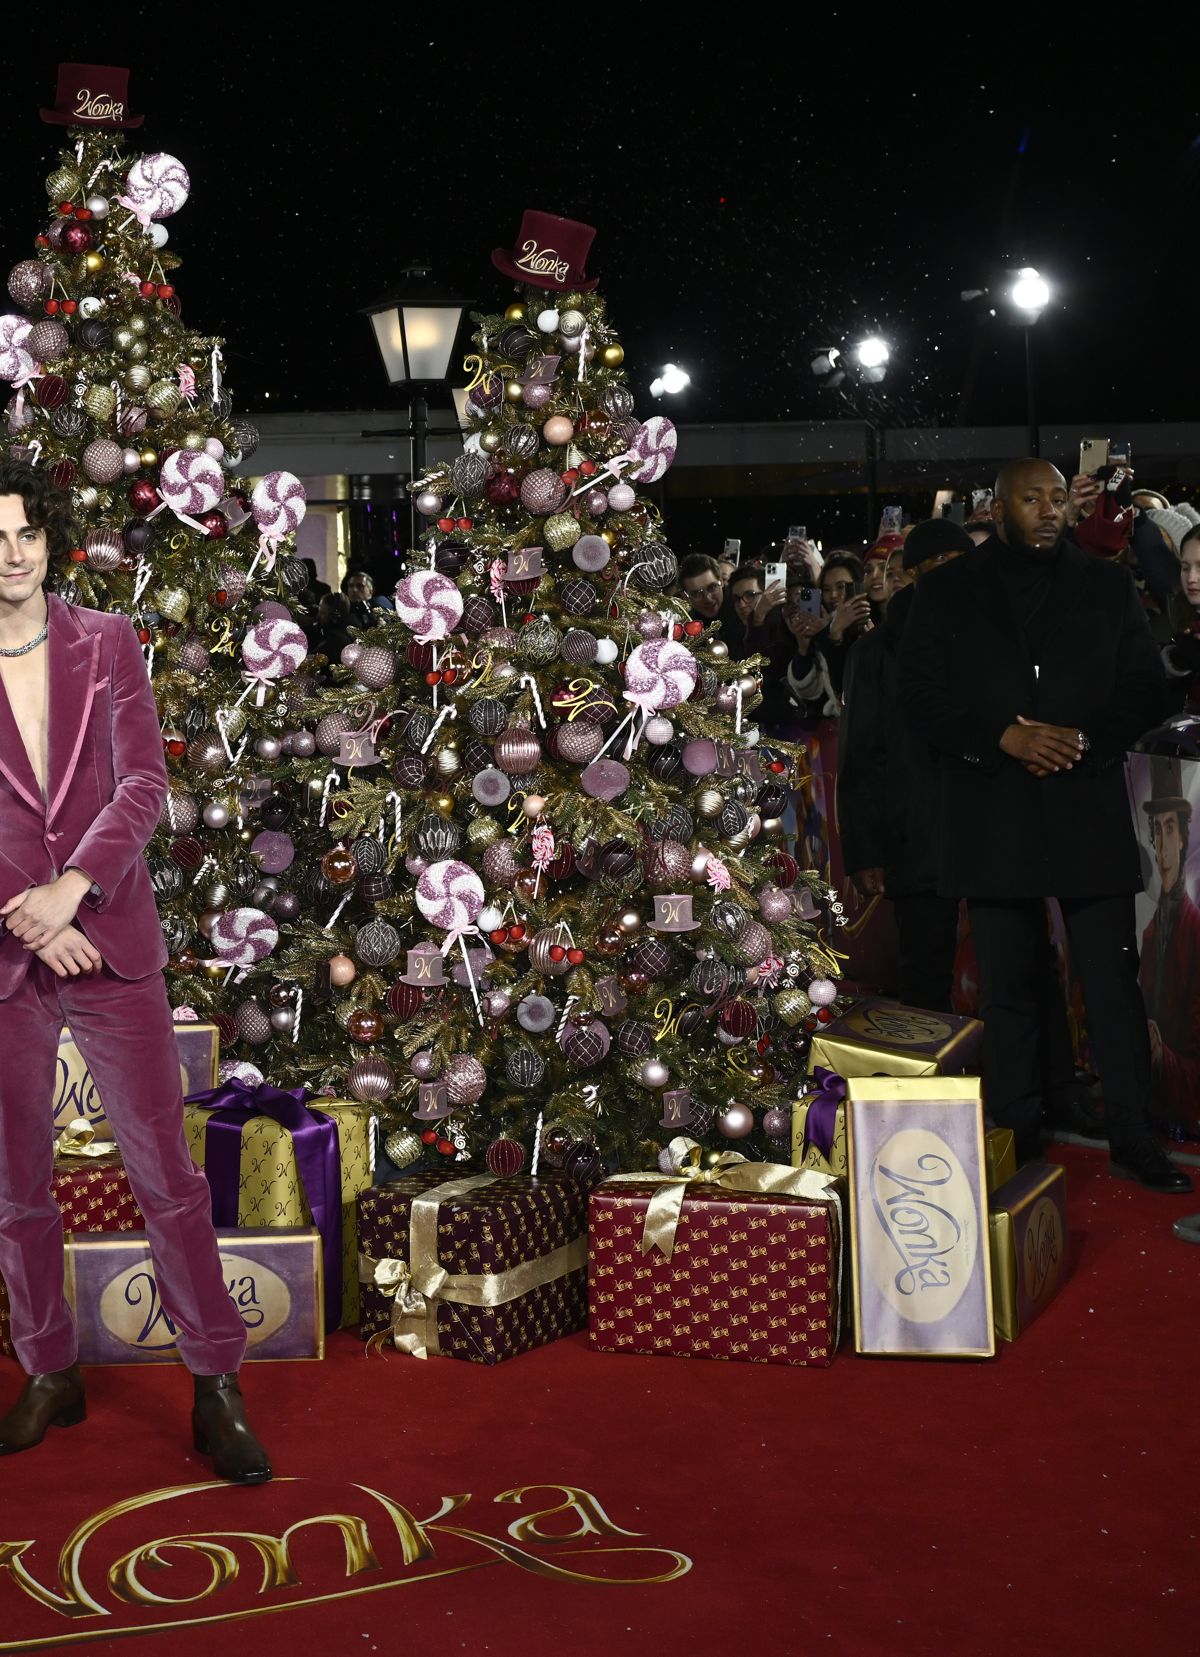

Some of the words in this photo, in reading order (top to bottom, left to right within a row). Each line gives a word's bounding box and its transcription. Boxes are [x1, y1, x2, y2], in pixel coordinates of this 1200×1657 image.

[72, 88, 124, 121] Wonka
[514, 239, 570, 283] Wonka
[463, 354, 514, 394] W
[530, 361, 550, 378] W
[514, 555, 534, 576] W
[552, 677, 618, 722] W
[346, 739, 367, 760] W
[661, 900, 689, 924] W
[414, 957, 439, 980] W
[654, 998, 700, 1042] W
[425, 1087, 439, 1111] W
[667, 1096, 684, 1121] W
[263, 1141, 277, 1155] W
[252, 1158, 265, 1173] W
[277, 1161, 291, 1177] W
[261, 1180, 276, 1194] W
[250, 1197, 264, 1212] W
[275, 1200, 291, 1216] W
[869, 1153, 962, 1296] Wonka
